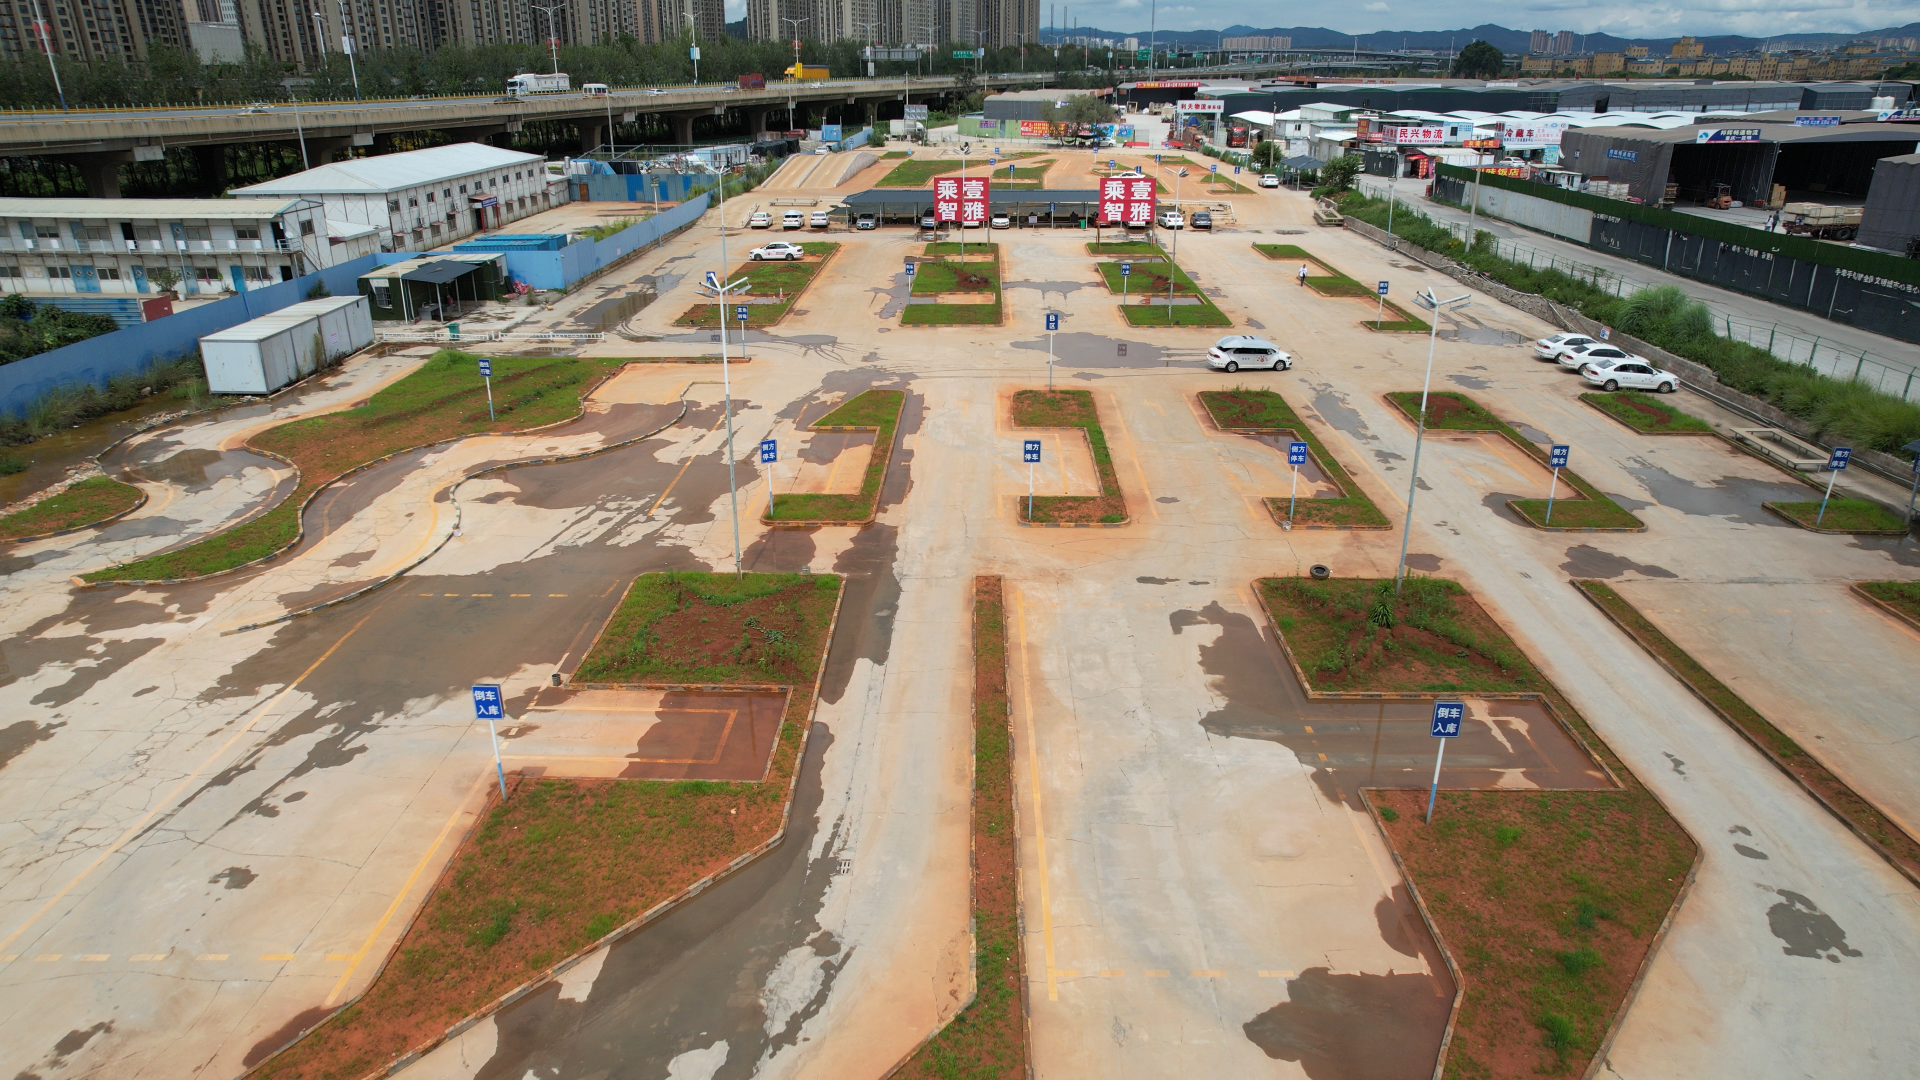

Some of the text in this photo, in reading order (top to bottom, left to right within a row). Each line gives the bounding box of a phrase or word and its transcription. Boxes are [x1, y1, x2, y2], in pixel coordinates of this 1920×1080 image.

[1399, 128, 1443, 139] 民兴物流
[1504, 128, 1534, 138] 冷藏车
[763, 443, 775, 451] 侧方
[1025, 443, 1039, 451] 侧方
[1291, 445, 1305, 453] 侧方
[1553, 448, 1567, 456] 侧方
[1834, 450, 1849, 458] 侧方
[762, 453, 775, 461] 停车
[474, 690, 496, 701] 倒车
[478, 704, 499, 716] 入库
[1437, 707, 1461, 719] 倒车
[1433, 722, 1457, 734] 入库
